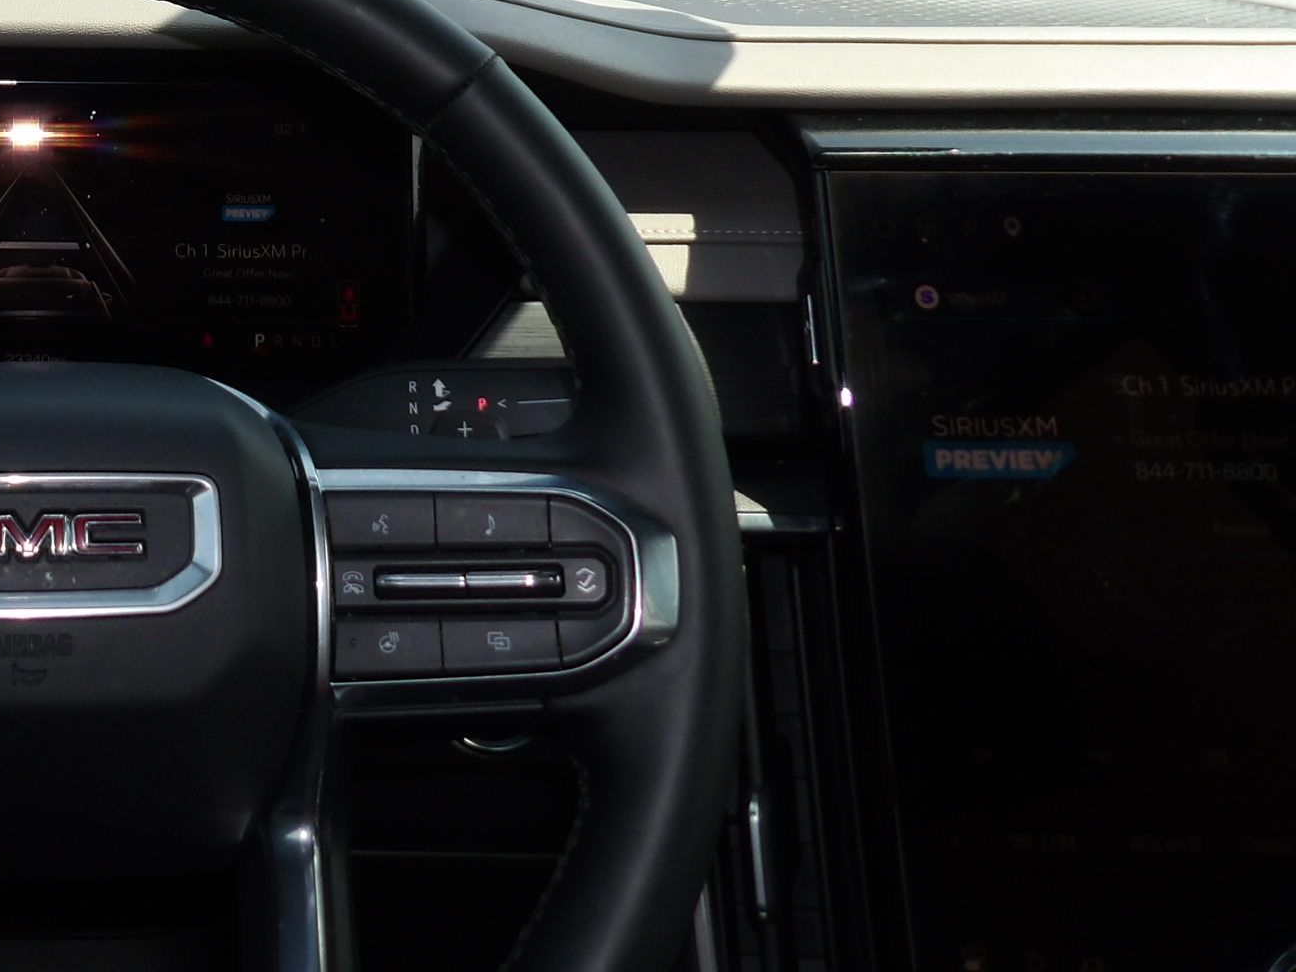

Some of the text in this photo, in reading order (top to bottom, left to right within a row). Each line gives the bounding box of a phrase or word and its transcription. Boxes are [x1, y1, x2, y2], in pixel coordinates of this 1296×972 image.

[225, 208, 270, 219] PREVIEW
[175, 243, 196, 259] Ch
[202, 244, 209, 259] 1
[216, 243, 286, 259] SiriusXM
[254, 333, 265, 348] P
[408, 381, 418, 394] R
[1120, 375, 1153, 396] Ch
[1161, 376, 1169, 396] 1
[1179, 375, 1276, 397] SiriusXM
[408, 402, 419, 415] N
[477, 398, 488, 412] P
[935, 448, 1063, 470] PREVIEW
[1135, 461, 1280, 482] 844-711-8800
